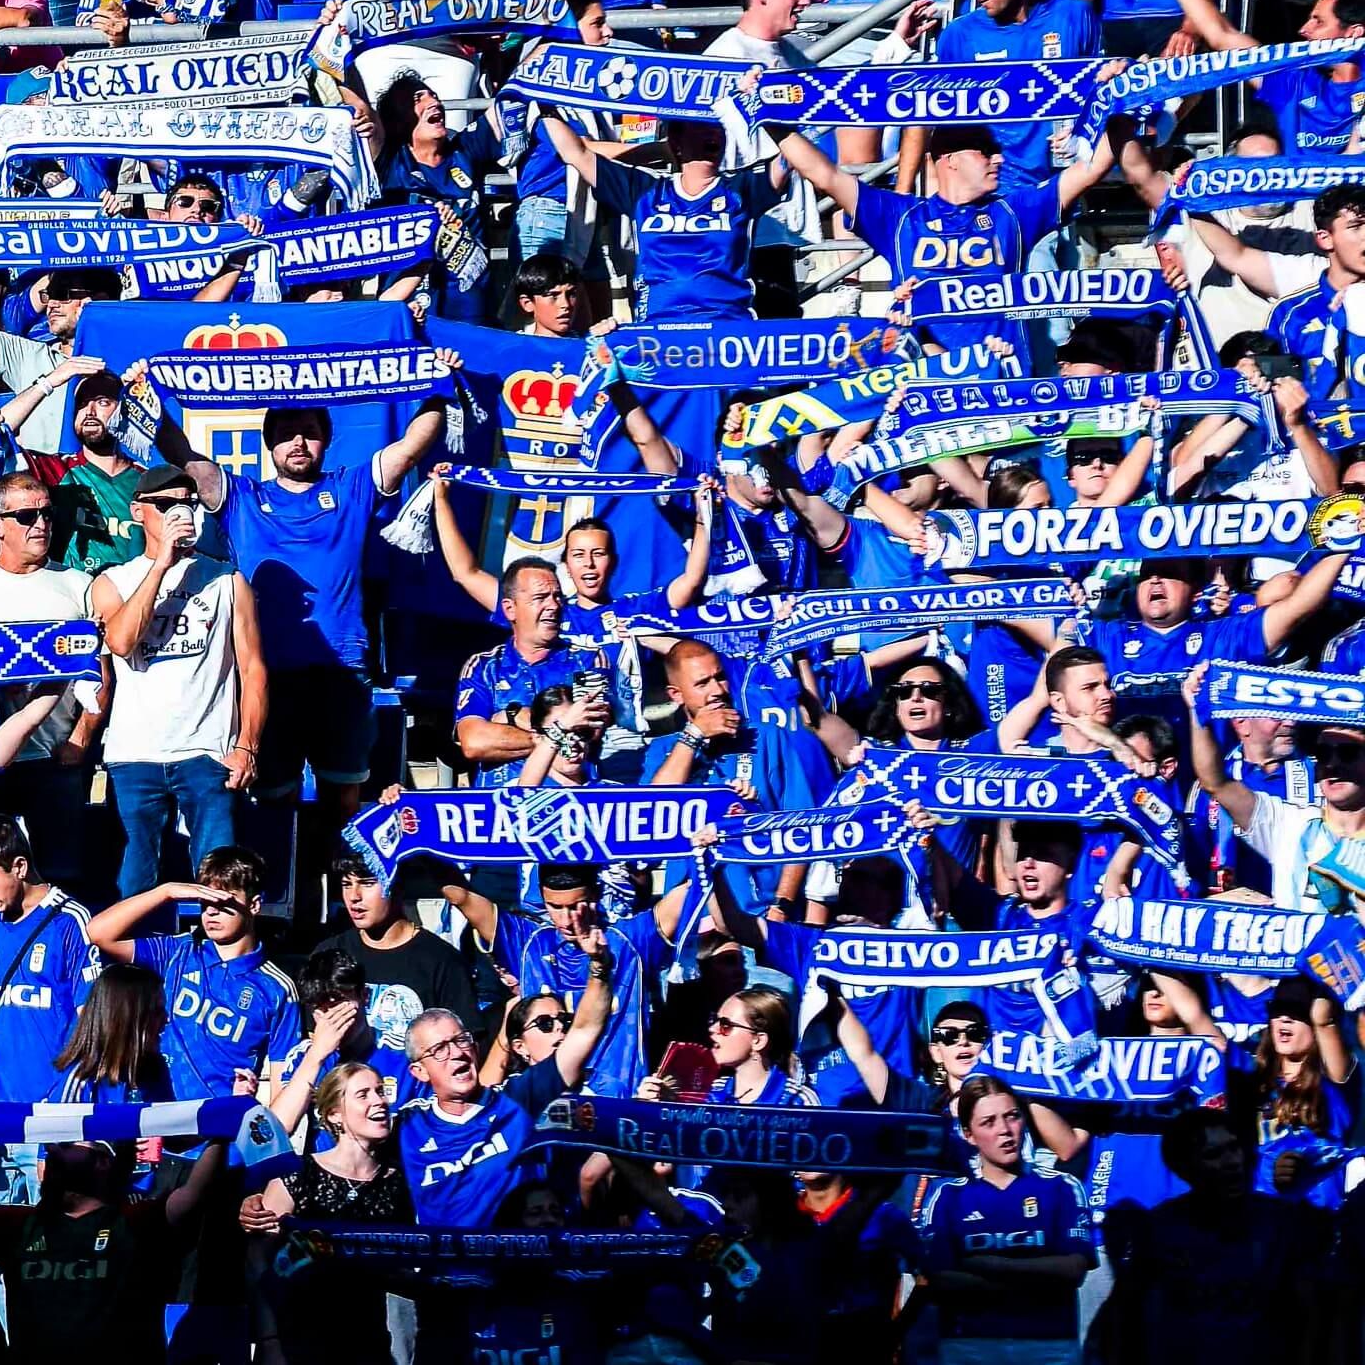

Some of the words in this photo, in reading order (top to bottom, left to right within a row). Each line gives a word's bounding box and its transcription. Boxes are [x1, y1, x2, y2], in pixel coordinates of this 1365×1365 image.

[885, 86, 1011, 119] CICLO
[641, 212, 732, 233] DIGI
[941, 273, 1012, 312] Real
[1023, 268, 1153, 304] OVIEDO
[155, 354, 450, 394] INQUEBRANTABLES
[977, 506, 1121, 556] FORZA
[1138, 499, 1307, 549] OVIEDO
[917, 590, 999, 615] VALOR
[1011, 588, 1028, 609] Y
[935, 776, 1059, 808] CICLO
[437, 801, 535, 845] REAL
[567, 799, 708, 842] OVIEDO
[420, 1132, 509, 1188] DIGI
[964, 1230, 1045, 1250] DIGI
